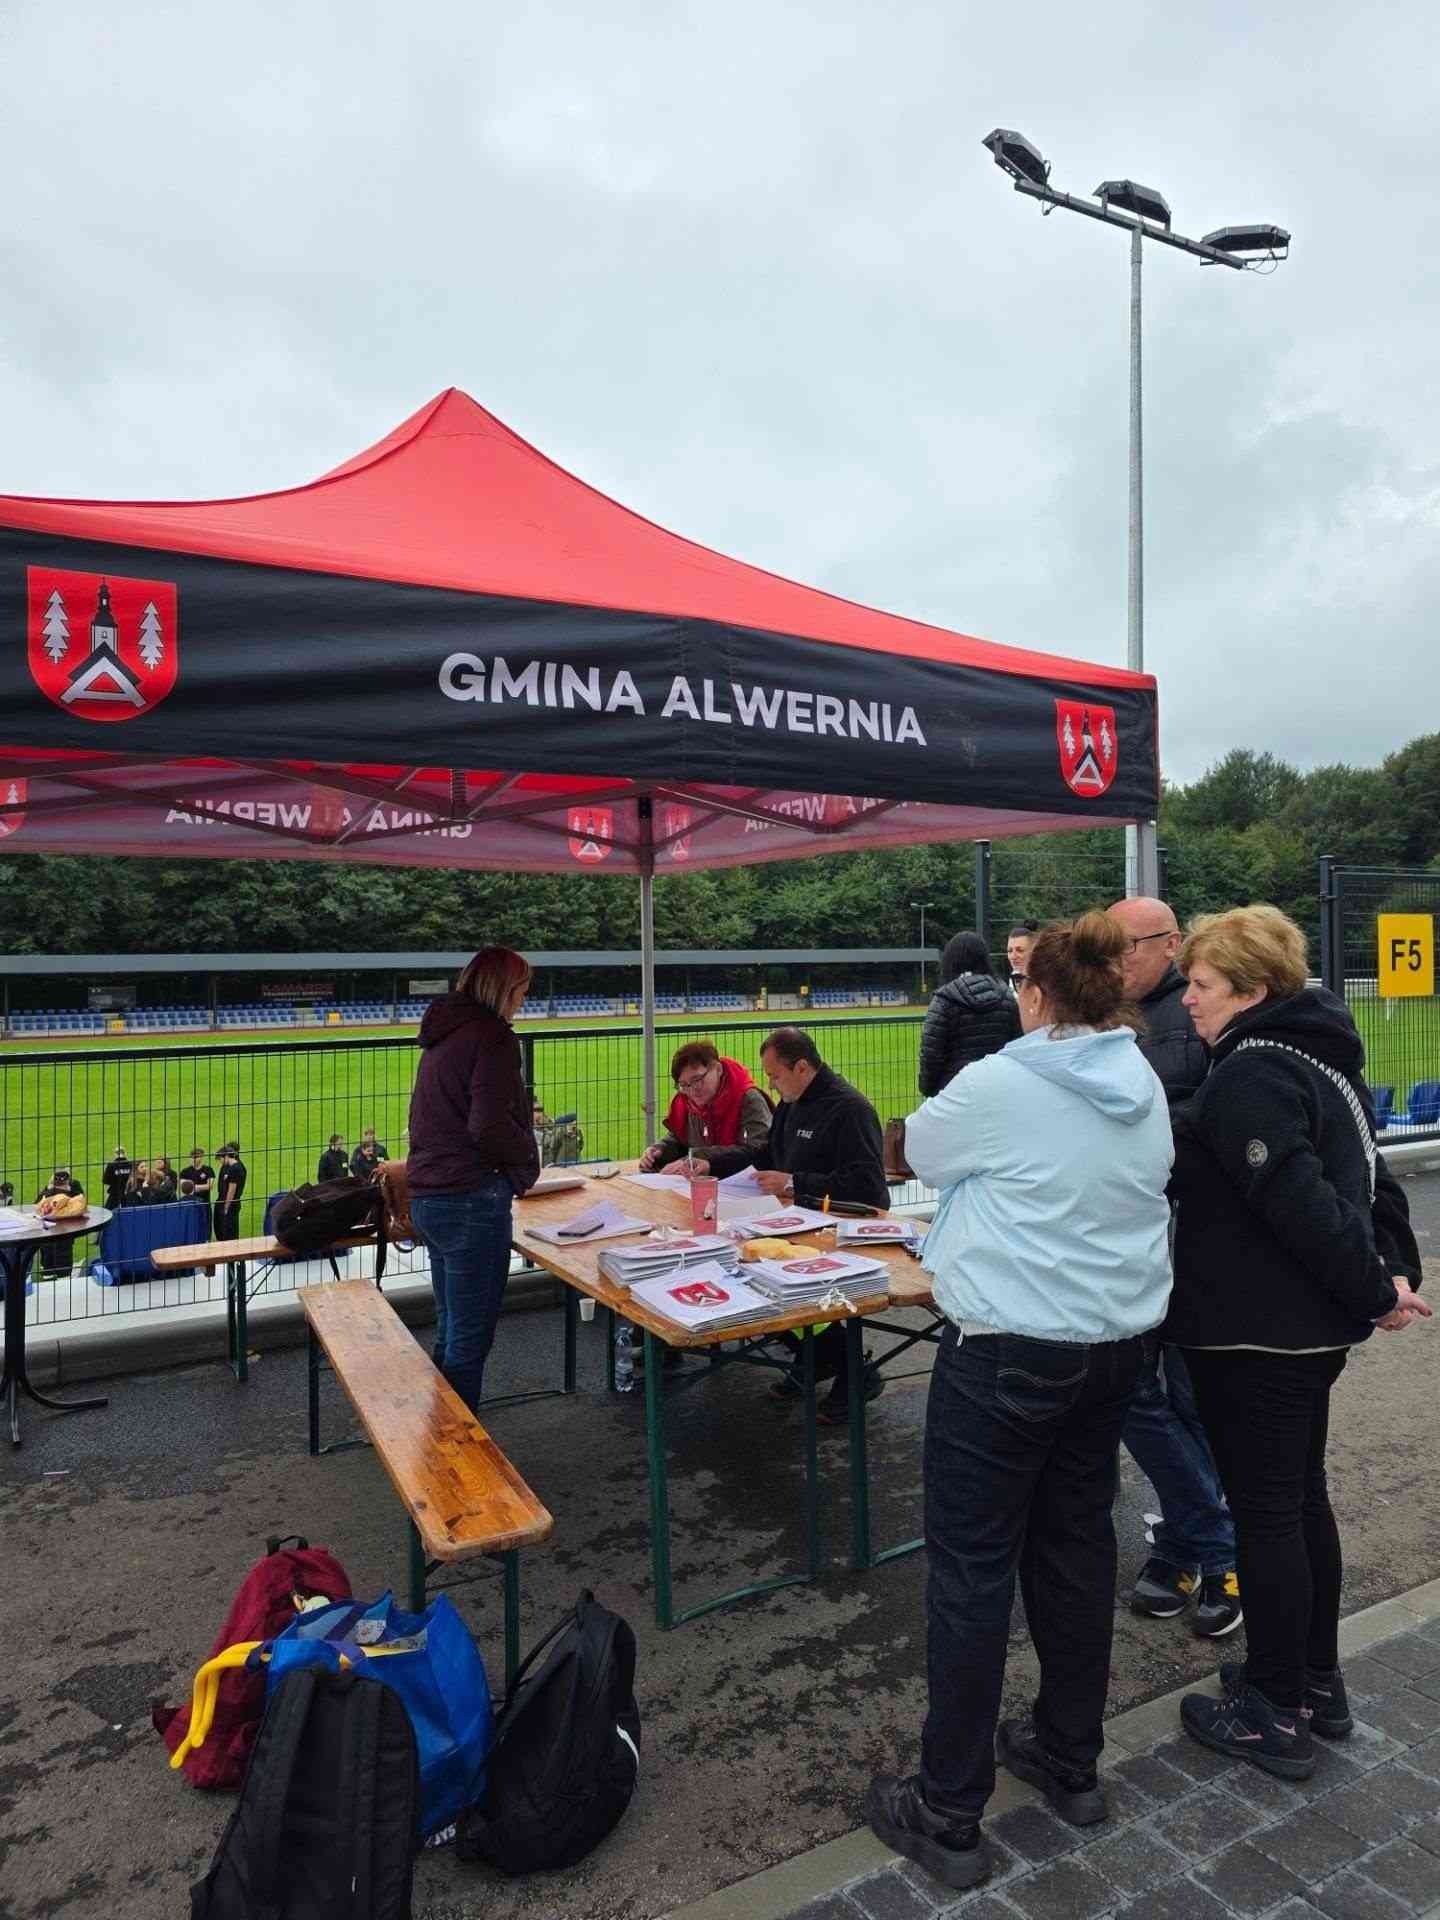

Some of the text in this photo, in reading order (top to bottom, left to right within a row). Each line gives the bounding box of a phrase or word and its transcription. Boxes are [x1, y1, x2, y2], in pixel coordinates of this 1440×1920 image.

[438, 652, 927, 746] GMINA ALWERNIA
[1391, 939, 1422, 972] F5
[434, 1823, 456, 1846] JYS
